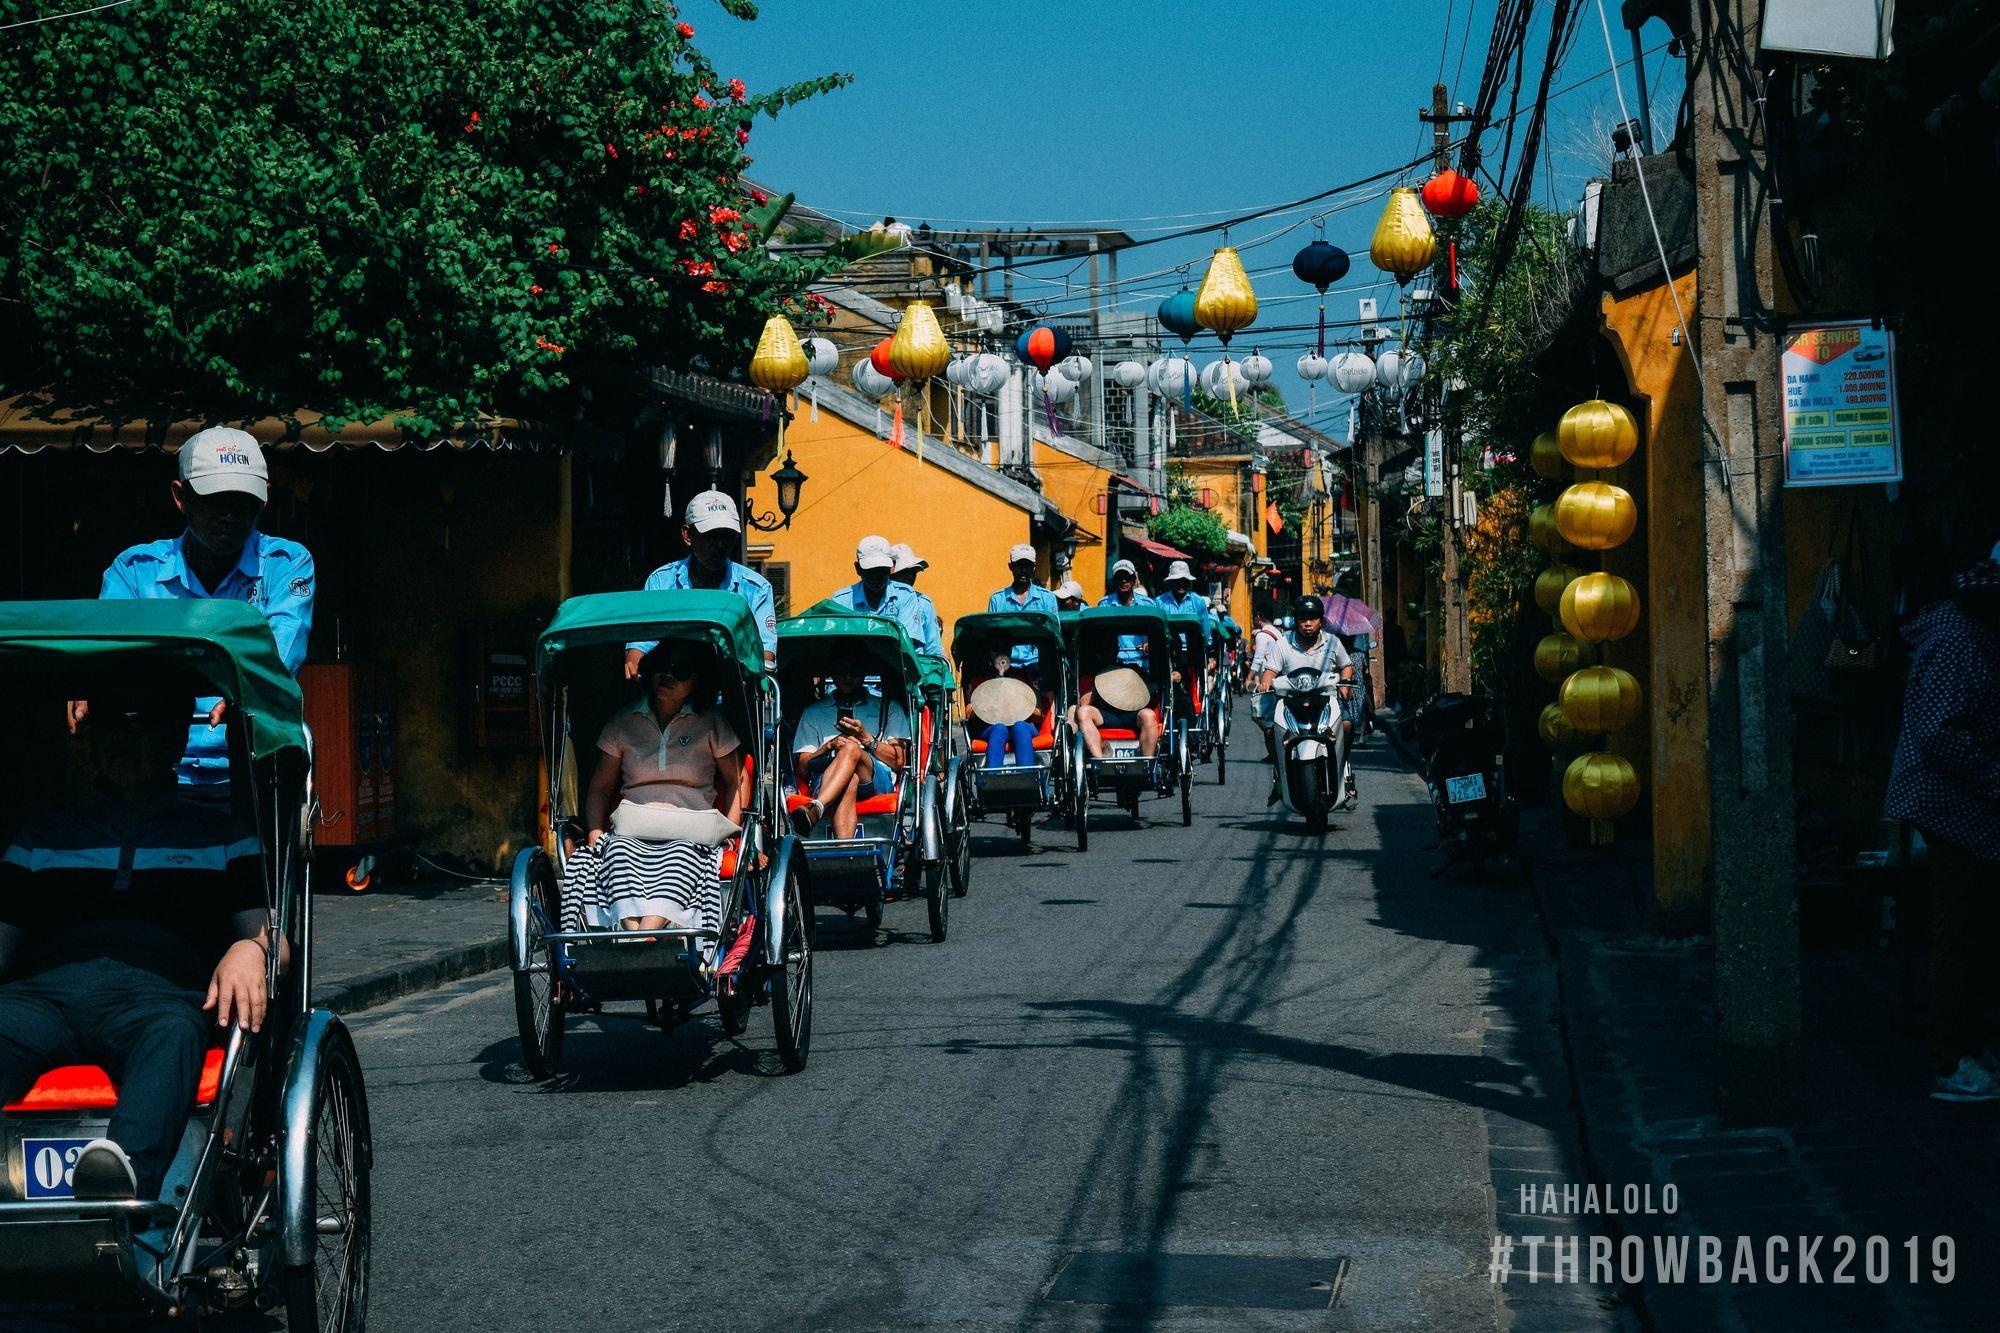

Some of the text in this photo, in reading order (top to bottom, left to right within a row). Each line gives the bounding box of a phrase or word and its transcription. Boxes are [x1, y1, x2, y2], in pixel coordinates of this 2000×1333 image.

[1813, 330, 1859, 345] SERVICE
[1815, 346, 1830, 360] TO
[1787, 387, 1802, 396] HUE
[1788, 399, 1799, 408] BA
[1815, 435, 1845, 445] STATION
[493, 675, 522, 687] PCCC
